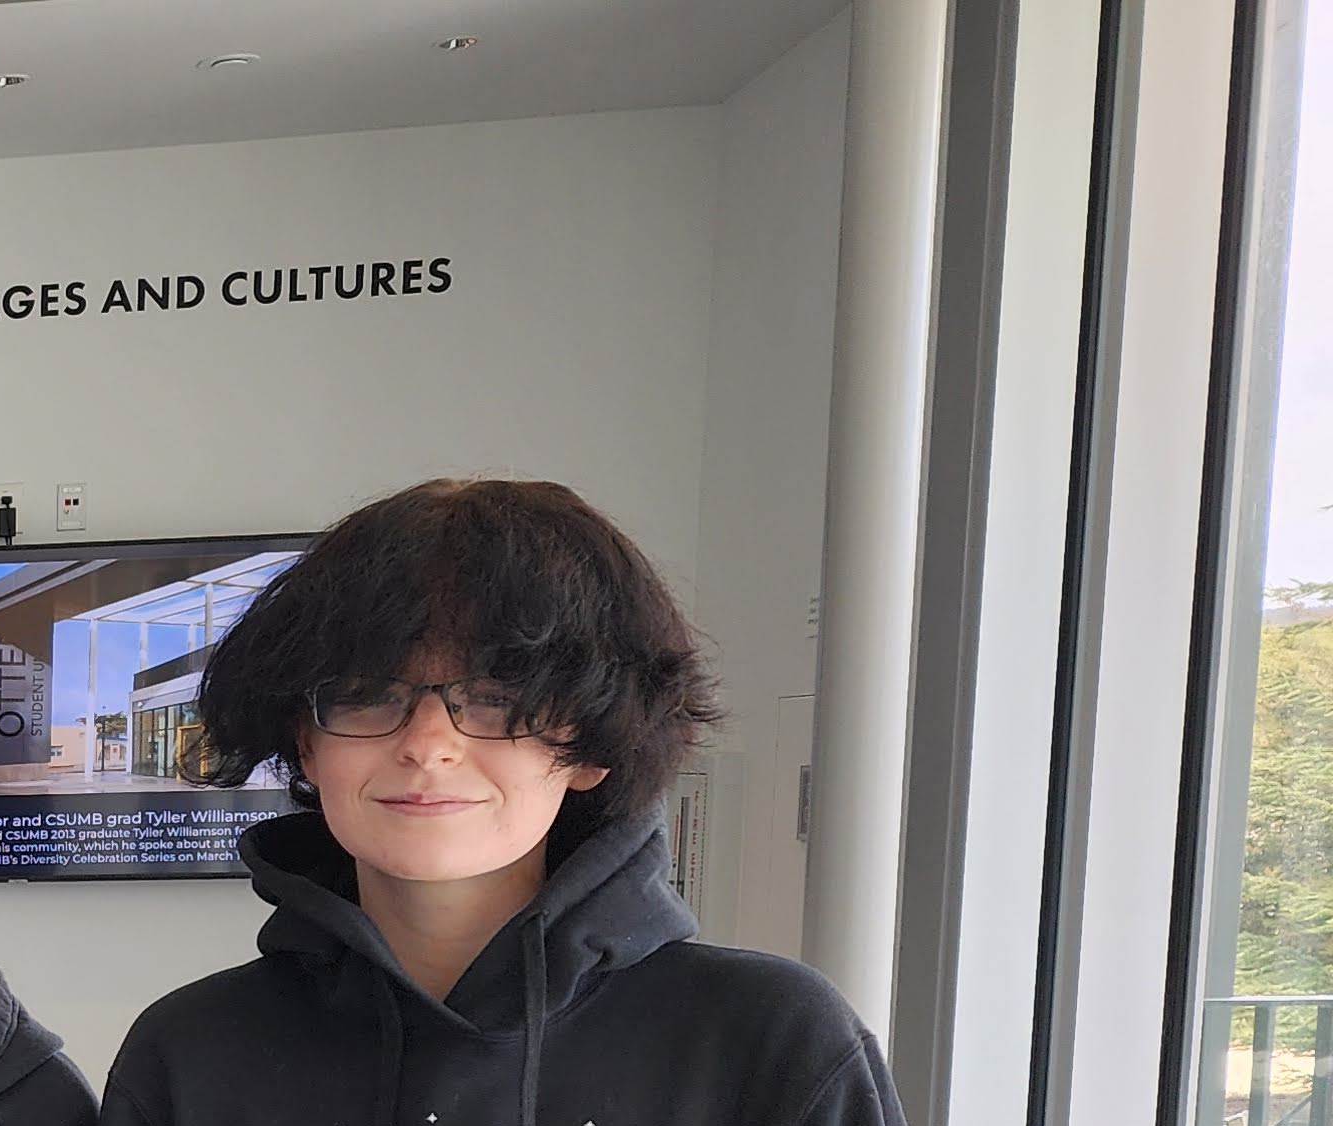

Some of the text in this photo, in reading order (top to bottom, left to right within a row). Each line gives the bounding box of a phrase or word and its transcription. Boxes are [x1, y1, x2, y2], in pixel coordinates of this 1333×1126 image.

[100, 275, 206, 314] AND
[221, 257, 453, 306] CULTURES
[31, 675, 44, 736] STUDENT
[12, 813, 42, 827] and
[45, 813, 103, 827] CSUMB
[106, 811, 142, 827] grad
[145, 810, 188, 826] Tyller
[191, 808, 278, 823] Williamson
[5, 830, 49, 841] CSUMB
[50, 829, 76, 840] 2013
[78, 828, 131, 841] graduate
[132, 827, 165, 839] Tyller
[166, 826, 233, 837] Williamson
[13, 841, 82, 853] community,
[83, 840, 119, 851] which
[121, 840, 137, 850] he
[139, 839, 174, 851] spoke
[176, 838, 211, 849] about
[214, 839, 226, 849] at
[20, 854, 70, 866] Diversity
[72, 852, 138, 864] Celebration
[141, 852, 176, 863] Series
[178, 853, 194, 862] on
[197, 850, 233, 861] March
